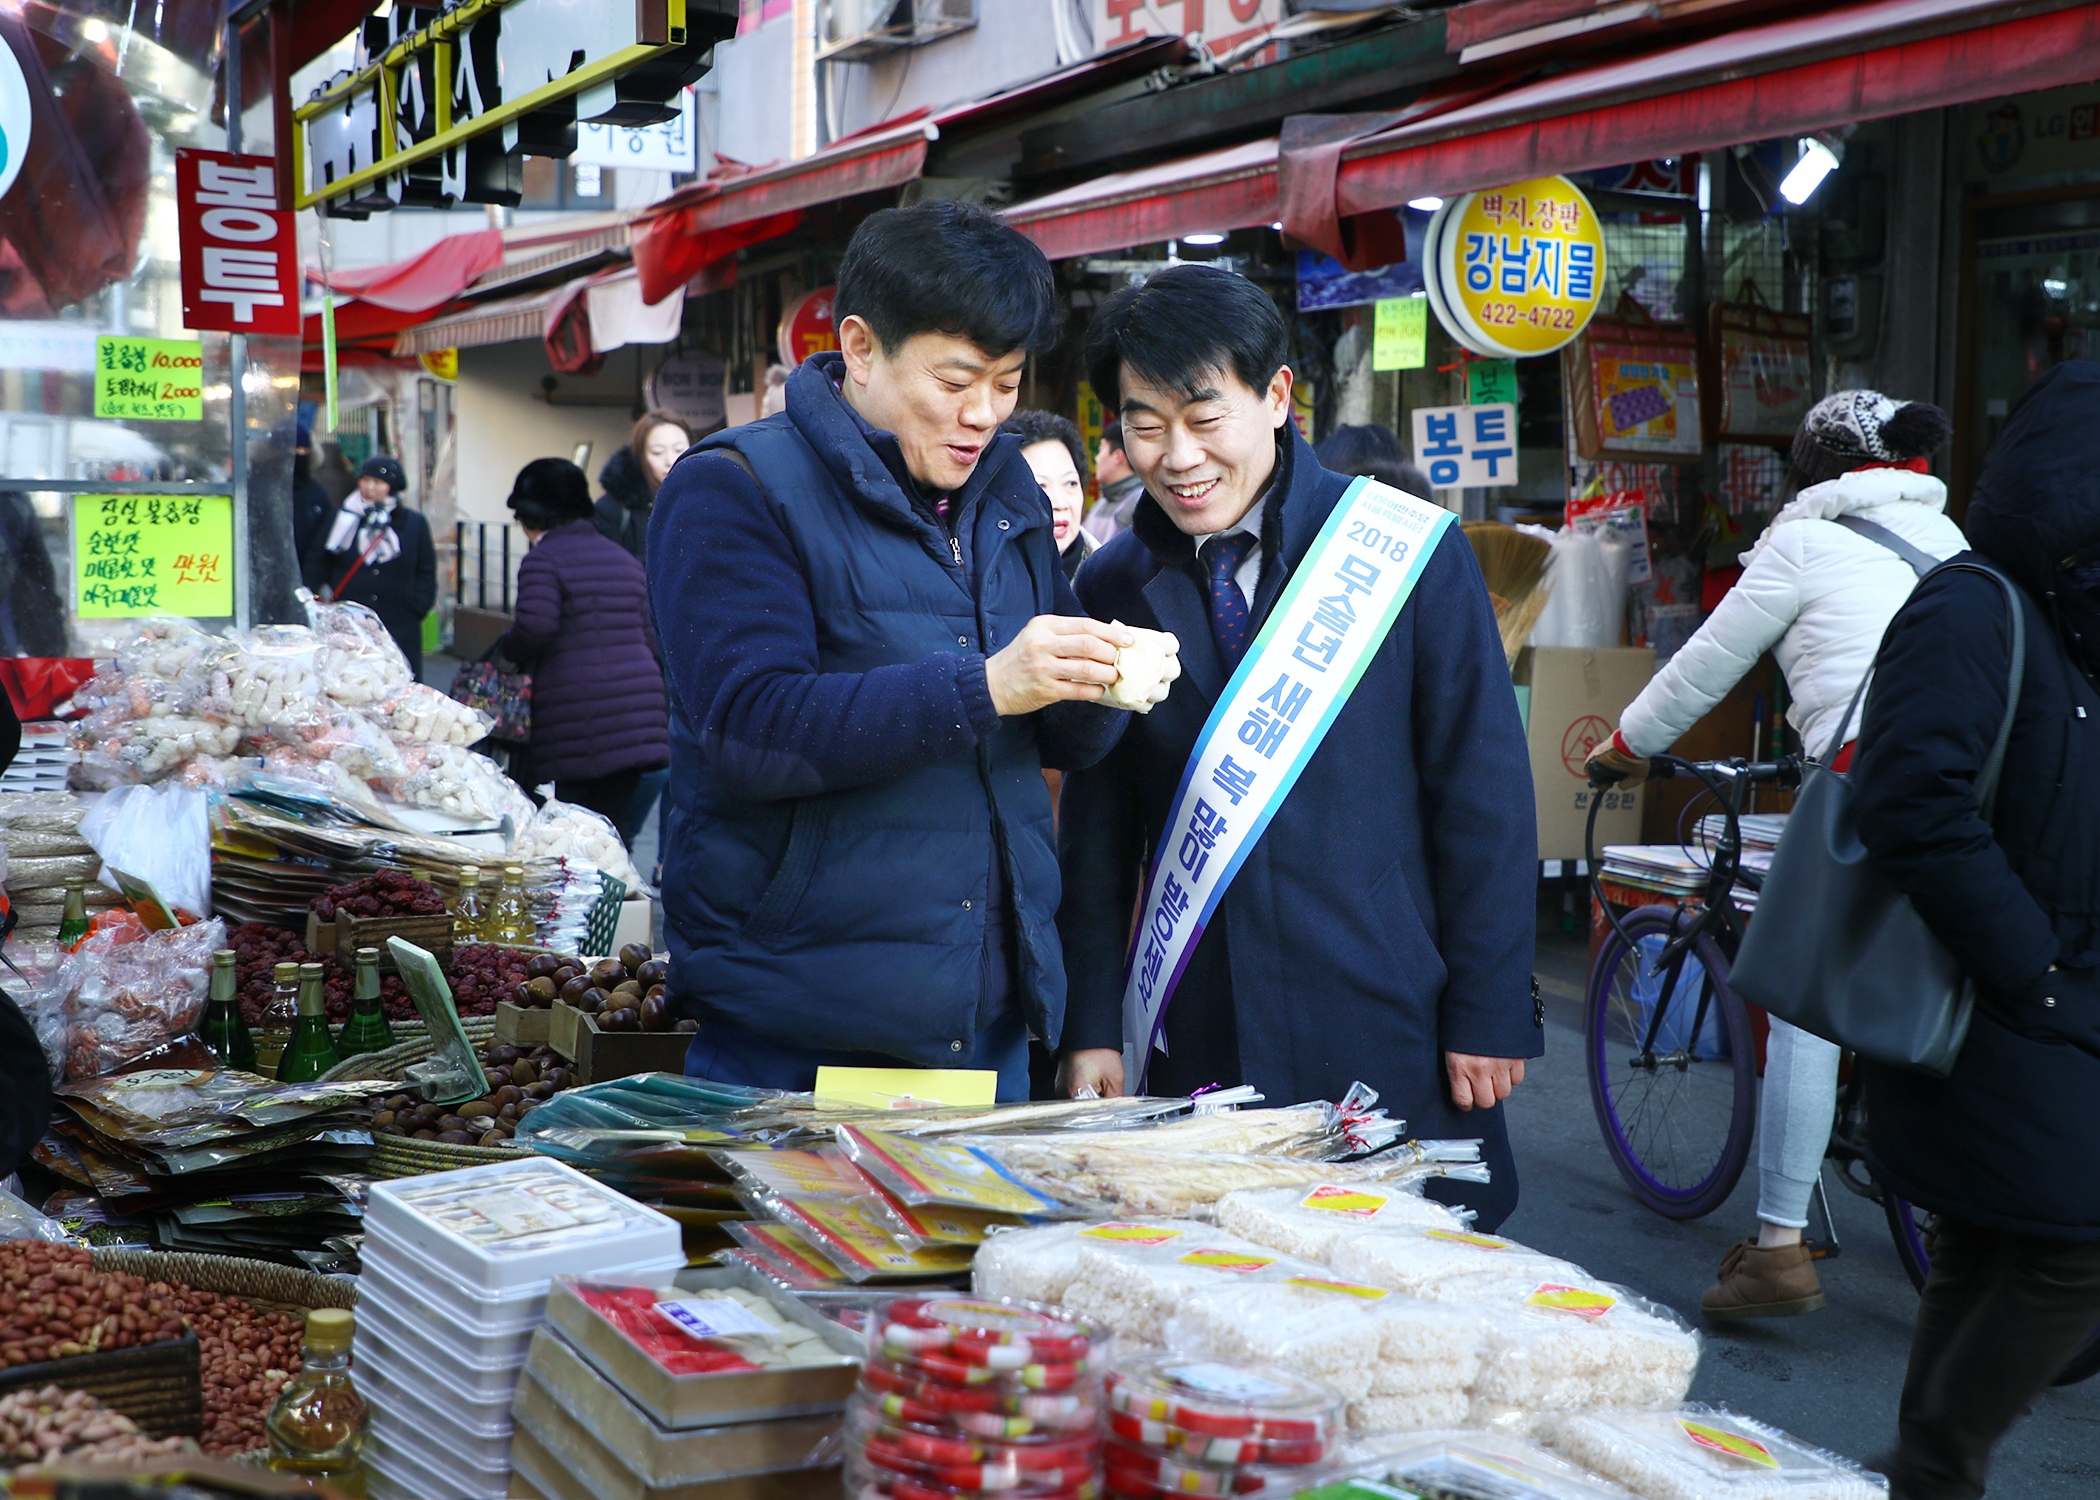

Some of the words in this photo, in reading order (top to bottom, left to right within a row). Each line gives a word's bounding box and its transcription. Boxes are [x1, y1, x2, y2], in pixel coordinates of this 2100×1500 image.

[195, 159, 285, 324] 봉투
[1465, 233, 1595, 299] 강남지물
[1482, 302, 1576, 330] 422-4722
[152, 351, 203, 369] 10,000
[1423, 409, 1513, 486] 봉투
[1360, 500, 1425, 535] 서울특별시당
[1366, 491, 1431, 524] 더불어민주당
[1346, 520, 1409, 563] 2018
[1291, 553, 1382, 673] 무술년
[1237, 672, 1313, 760] 새해
[1211, 753, 1258, 807] 복
[1178, 796, 1228, 885] 많이
[1137, 870, 1189, 1014] 받으세요
